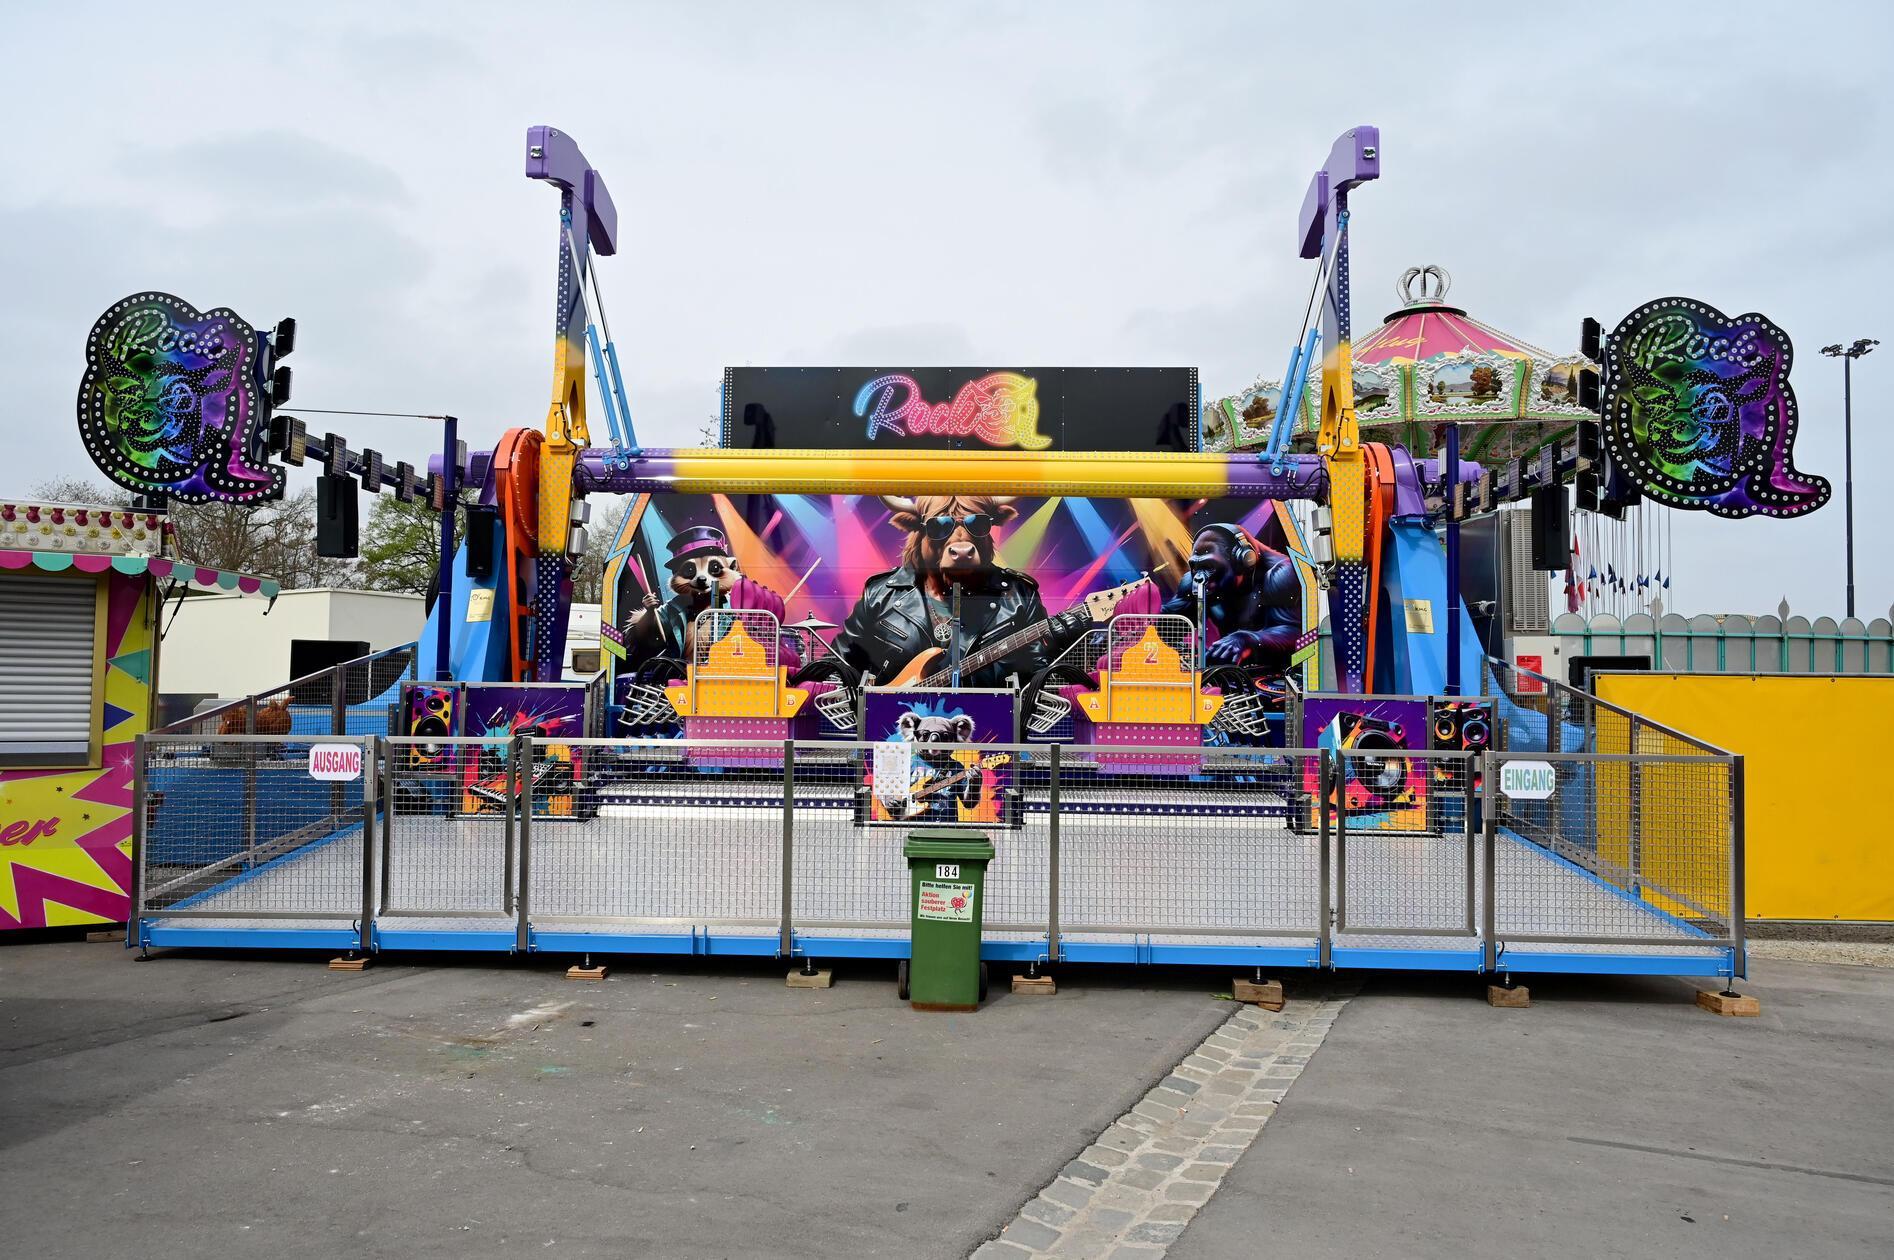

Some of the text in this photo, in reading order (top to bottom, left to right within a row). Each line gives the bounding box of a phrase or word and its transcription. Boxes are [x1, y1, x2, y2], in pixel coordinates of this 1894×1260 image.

[731, 635, 744, 656] 1
[1143, 642, 1158, 664] 2
[677, 693, 796, 706] A B
[1089, 697, 1214, 711] A B
[313, 751, 360, 773] AUSGANG
[1504, 768, 1554, 791] EINGANG
[938, 866, 957, 877] 184
